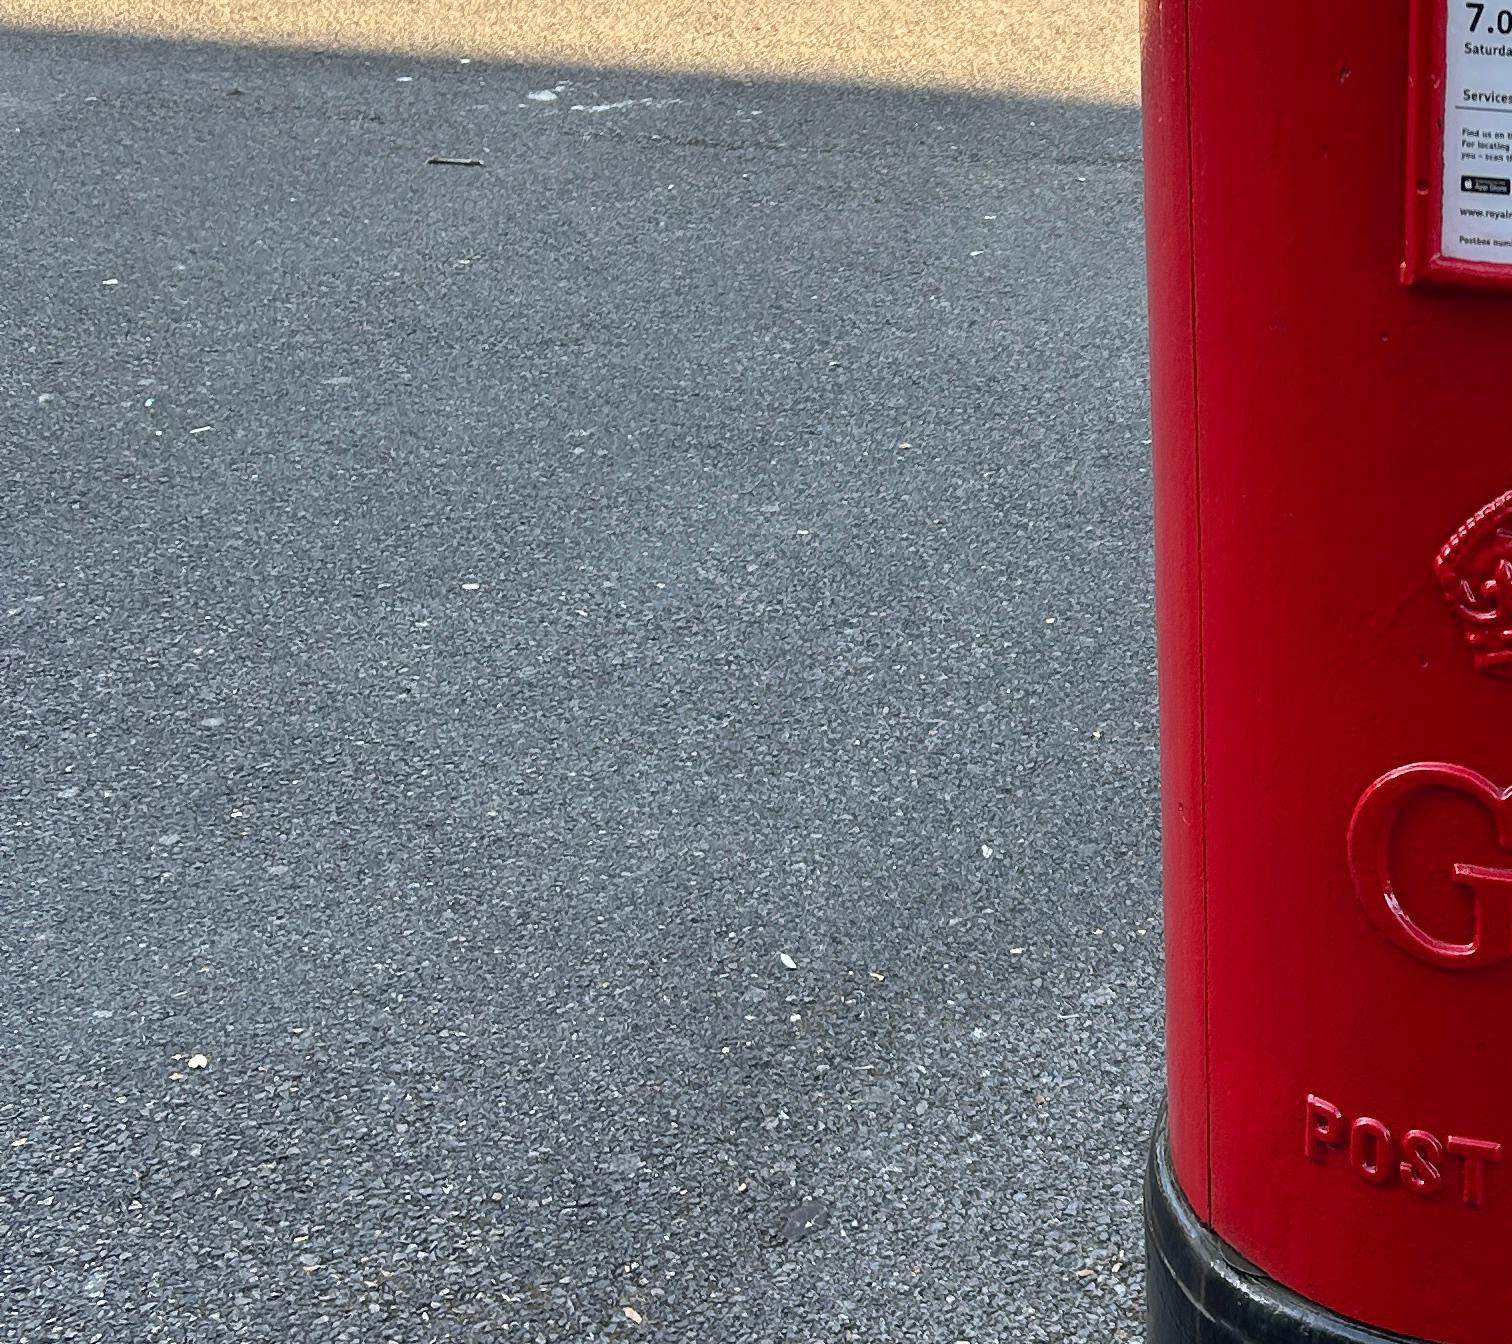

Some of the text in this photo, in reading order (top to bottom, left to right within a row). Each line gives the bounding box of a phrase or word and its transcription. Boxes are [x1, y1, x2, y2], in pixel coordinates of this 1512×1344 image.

[1462, 128, 1479, 137] Find
[1482, 131, 1492, 139] us
[1494, 131, 1504, 139] on
[1462, 139, 1475, 148] For
[1477, 141, 1510, 152] locating
[1461, 152, 1476, 161] you
[1485, 154, 1504, 162] scan
[1459, 235, 1491, 247] Postbox
[1305, 1094, 1501, 1208] POST
